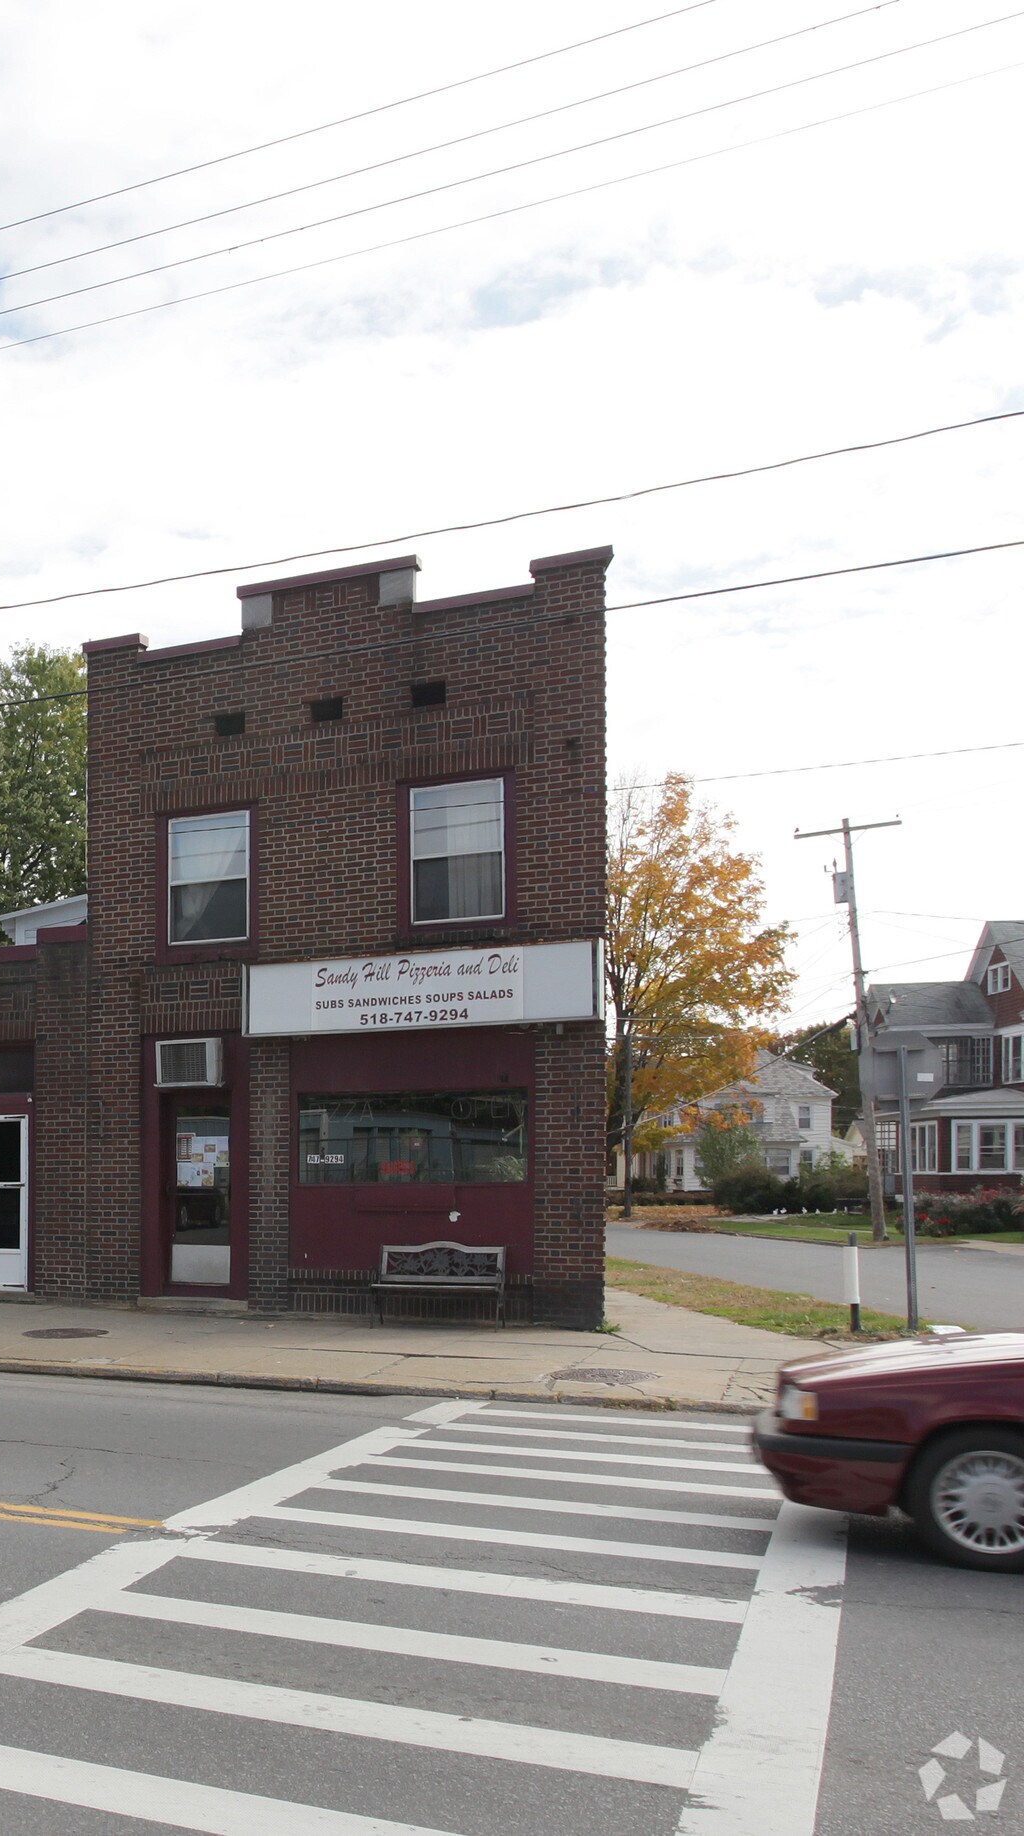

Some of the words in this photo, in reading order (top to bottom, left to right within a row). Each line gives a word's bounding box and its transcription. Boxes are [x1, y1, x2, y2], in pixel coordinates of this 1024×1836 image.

[315, 967, 358, 989] Sandy
[362, 962, 391, 982] Hill
[397, 959, 451, 985] Pizzeria
[457, 957, 484, 975] and
[488, 954, 520, 975] Deli
[315, 1000, 344, 1010] SUBS
[348, 995, 422, 1008] SANDWICHES
[426, 991, 464, 1004] SOUPS
[467, 988, 514, 1001] SALADS
[360, 1008, 469, 1026] 518-747-9294
